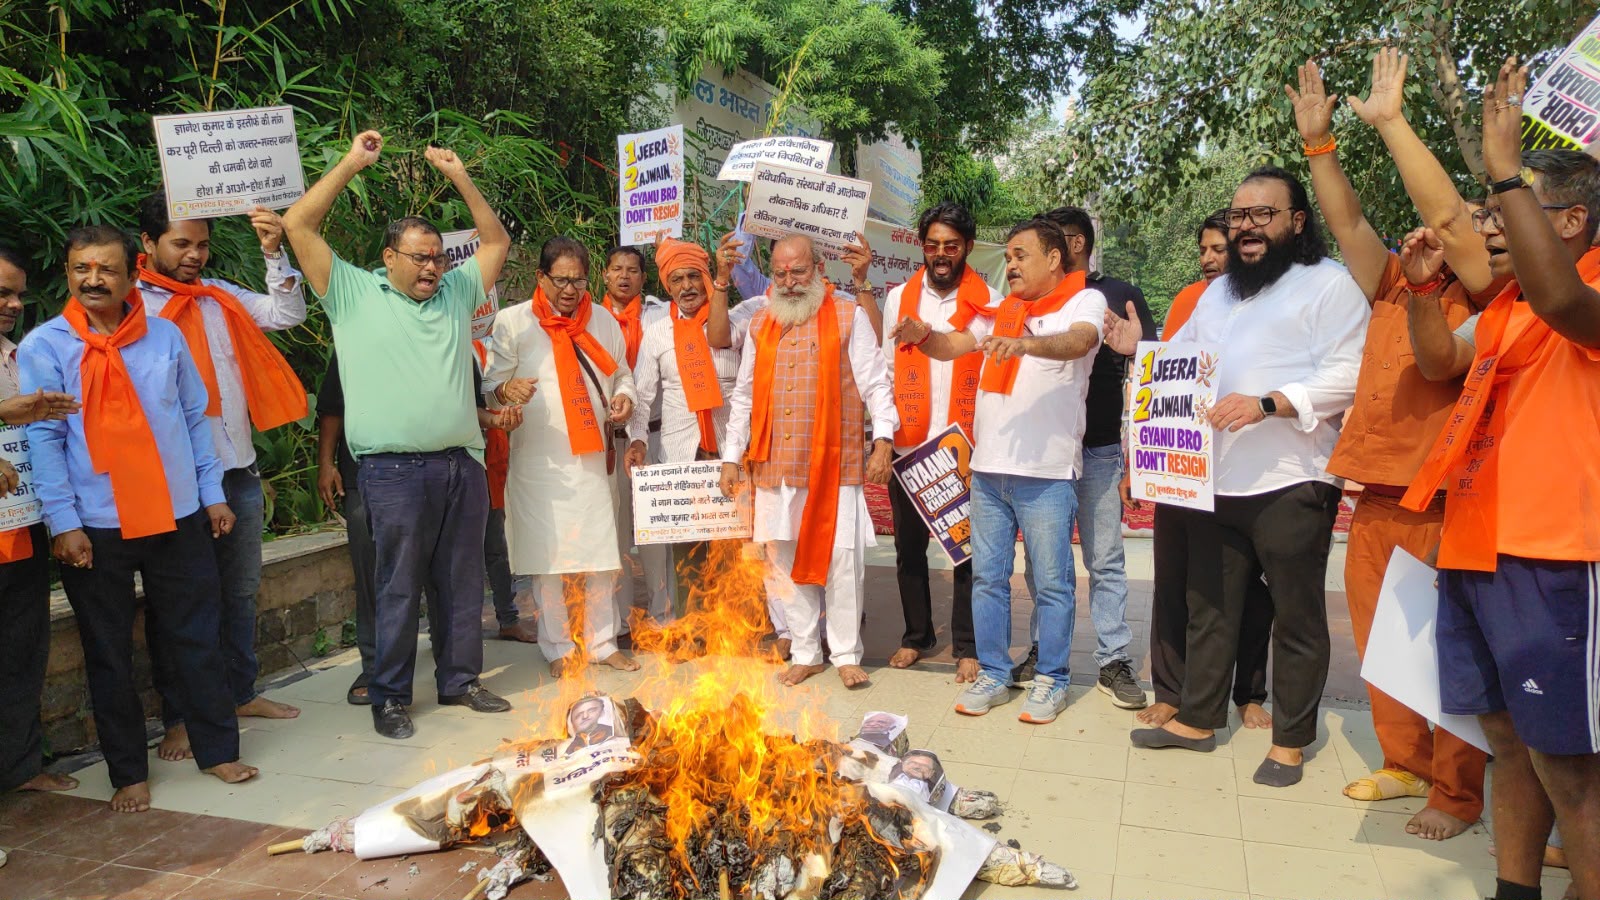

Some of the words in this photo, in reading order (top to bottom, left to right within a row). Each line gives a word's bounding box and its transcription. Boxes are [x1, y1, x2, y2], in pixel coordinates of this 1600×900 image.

[720, 87, 759, 124] भारत
[174, 120, 199, 135] ज्ञानेश
[203, 120, 225, 136] कुमार
[226, 116, 234, 129] के
[237, 114, 260, 130] इस्तीफे
[261, 115, 270, 126] की
[166, 146, 181, 157] कर
[183, 142, 197, 160] पूरी
[200, 140, 223, 154] दिल्ली
[225, 138, 236, 150] को
[624, 140, 637, 166] 1
[637, 138, 668, 161] JEERA
[765, 138, 777, 147] की
[209, 161, 221, 175] की
[223, 159, 246, 173] धमकी
[247, 157, 259, 169] देने
[260, 156, 273, 169] वाले
[764, 151, 775, 159] पर
[814, 159, 824, 169] के
[196, 183, 214, 198] होश
[215, 182, 225, 195] में
[272, 174, 286, 187] आओ
[624, 165, 639, 192] 2
[638, 163, 673, 187] AJWAIN,
[796, 176, 825, 191] संस्थाओं
[826, 182, 835, 194] की
[630, 189, 659, 207] GYANU
[660, 185, 677, 201] BRO
[626, 208, 652, 224] DON'T
[653, 202, 679, 221] RESIGN
[811, 202, 840, 218] अधिकार
[794, 220, 820, 234] बदनाम
[1139, 350, 1155, 387] 1
[1153, 356, 1198, 383] JEERA
[1133, 386, 1153, 423] 2
[1151, 394, 1195, 421] AJWAIN,
[2, 441, 19, 453] पर
[1139, 425, 1175, 448] GYANU
[1177, 428, 1203, 451] BRO
[901, 446, 958, 493] GYAANU
[1135, 449, 1166, 472] DON'T
[1167, 453, 1207, 478] RESIGN
[919, 484, 943, 503] TERA
[938, 472, 959, 490] TIME
[931, 517, 949, 534] YE
